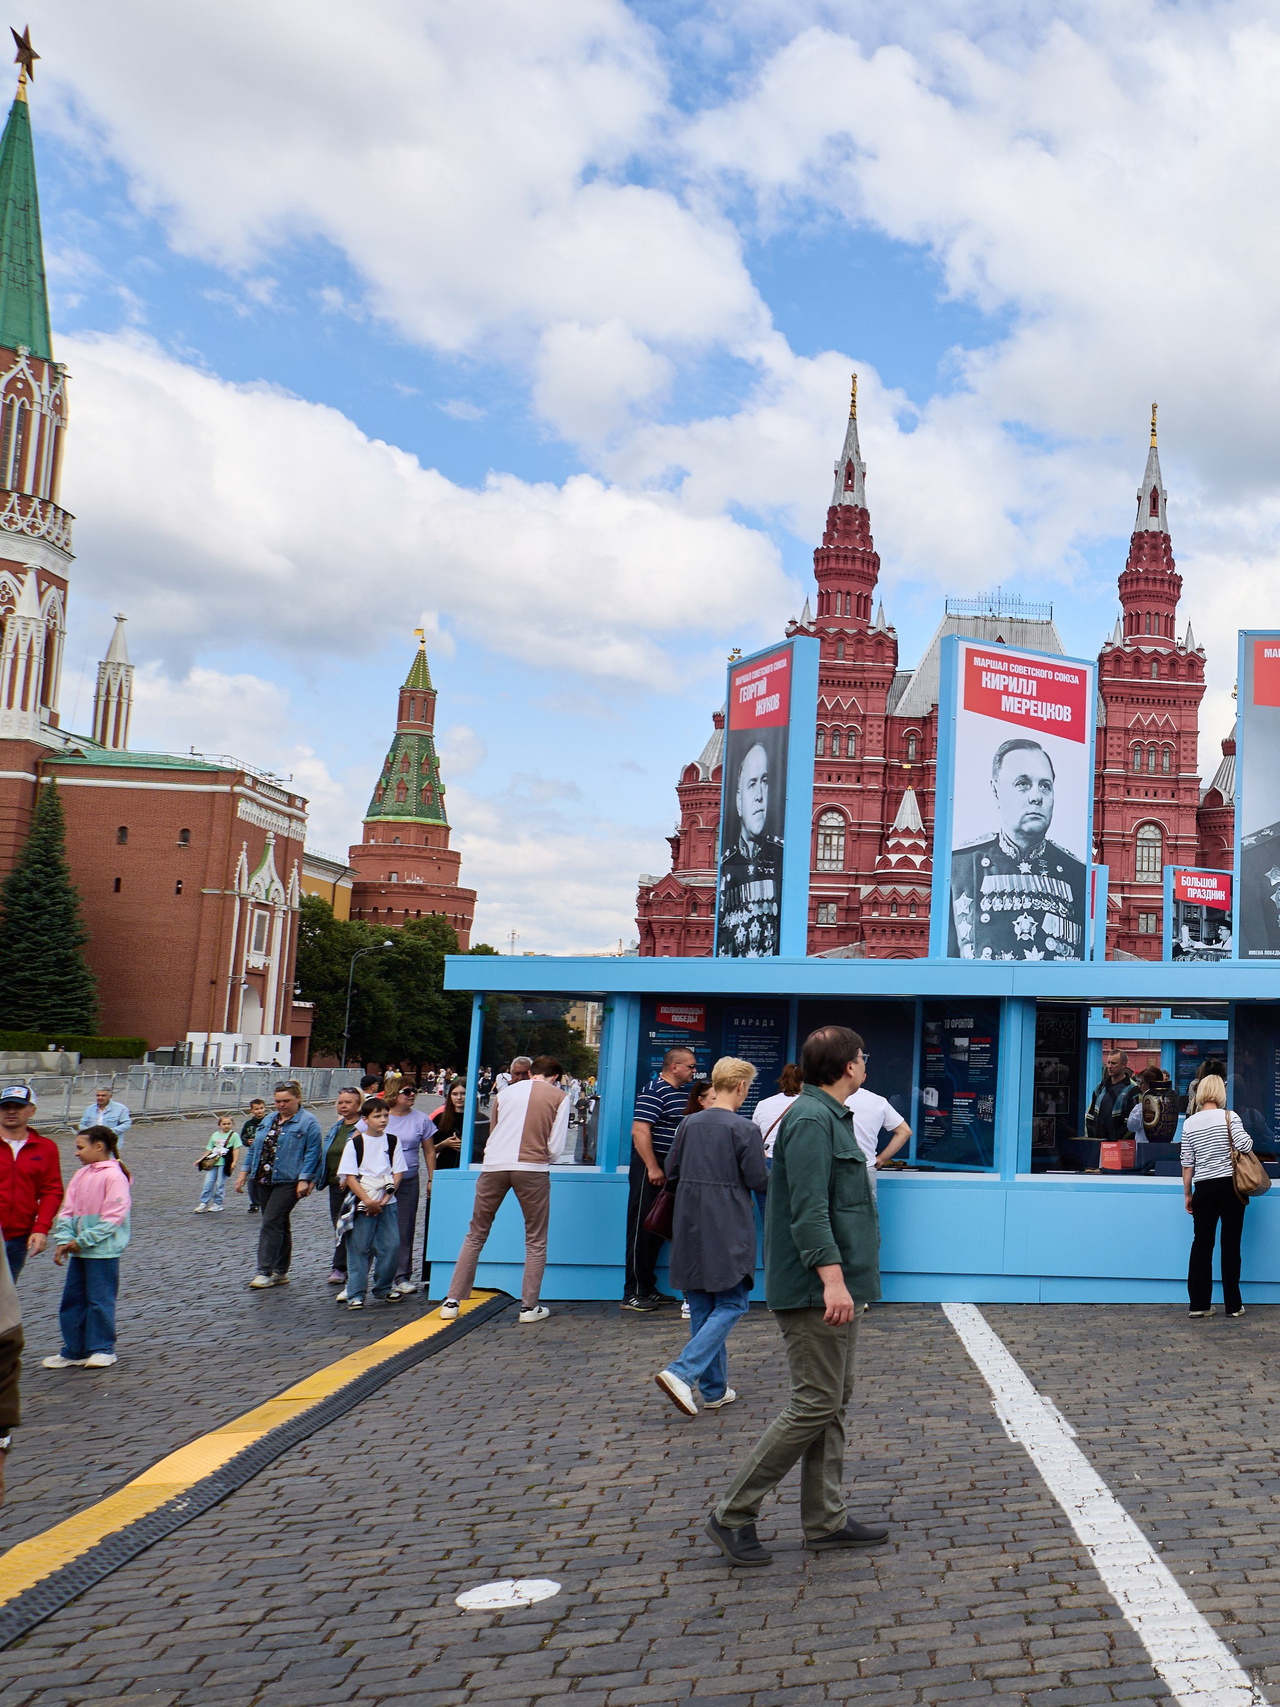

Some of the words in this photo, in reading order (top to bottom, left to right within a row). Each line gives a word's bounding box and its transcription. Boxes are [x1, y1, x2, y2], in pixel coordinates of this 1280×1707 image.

[973, 656, 1008, 671] МАРШАЛ
[1009, 663, 1053, 679] СОВЕТСКОГО
[1054, 672, 1079, 684] СОЮЗА
[739, 676, 767, 703] ГЕОРГИЙ
[982, 671, 1037, 697] КИРИЛЛ
[755, 693, 780, 717] ЖУКОВ
[1001, 695, 1072, 722] МЕРЕЦКОВ
[1181, 876, 1217, 889] БОЛЬШОЙ
[1187, 888, 1226, 901] ПРАЗДНИК
[660, 1006, 703, 1015] ПОЛКОВОДЦЫ
[671, 1015, 698, 1024] ПОБЕДЫ
[734, 1018, 775, 1027] ПАРАДА
